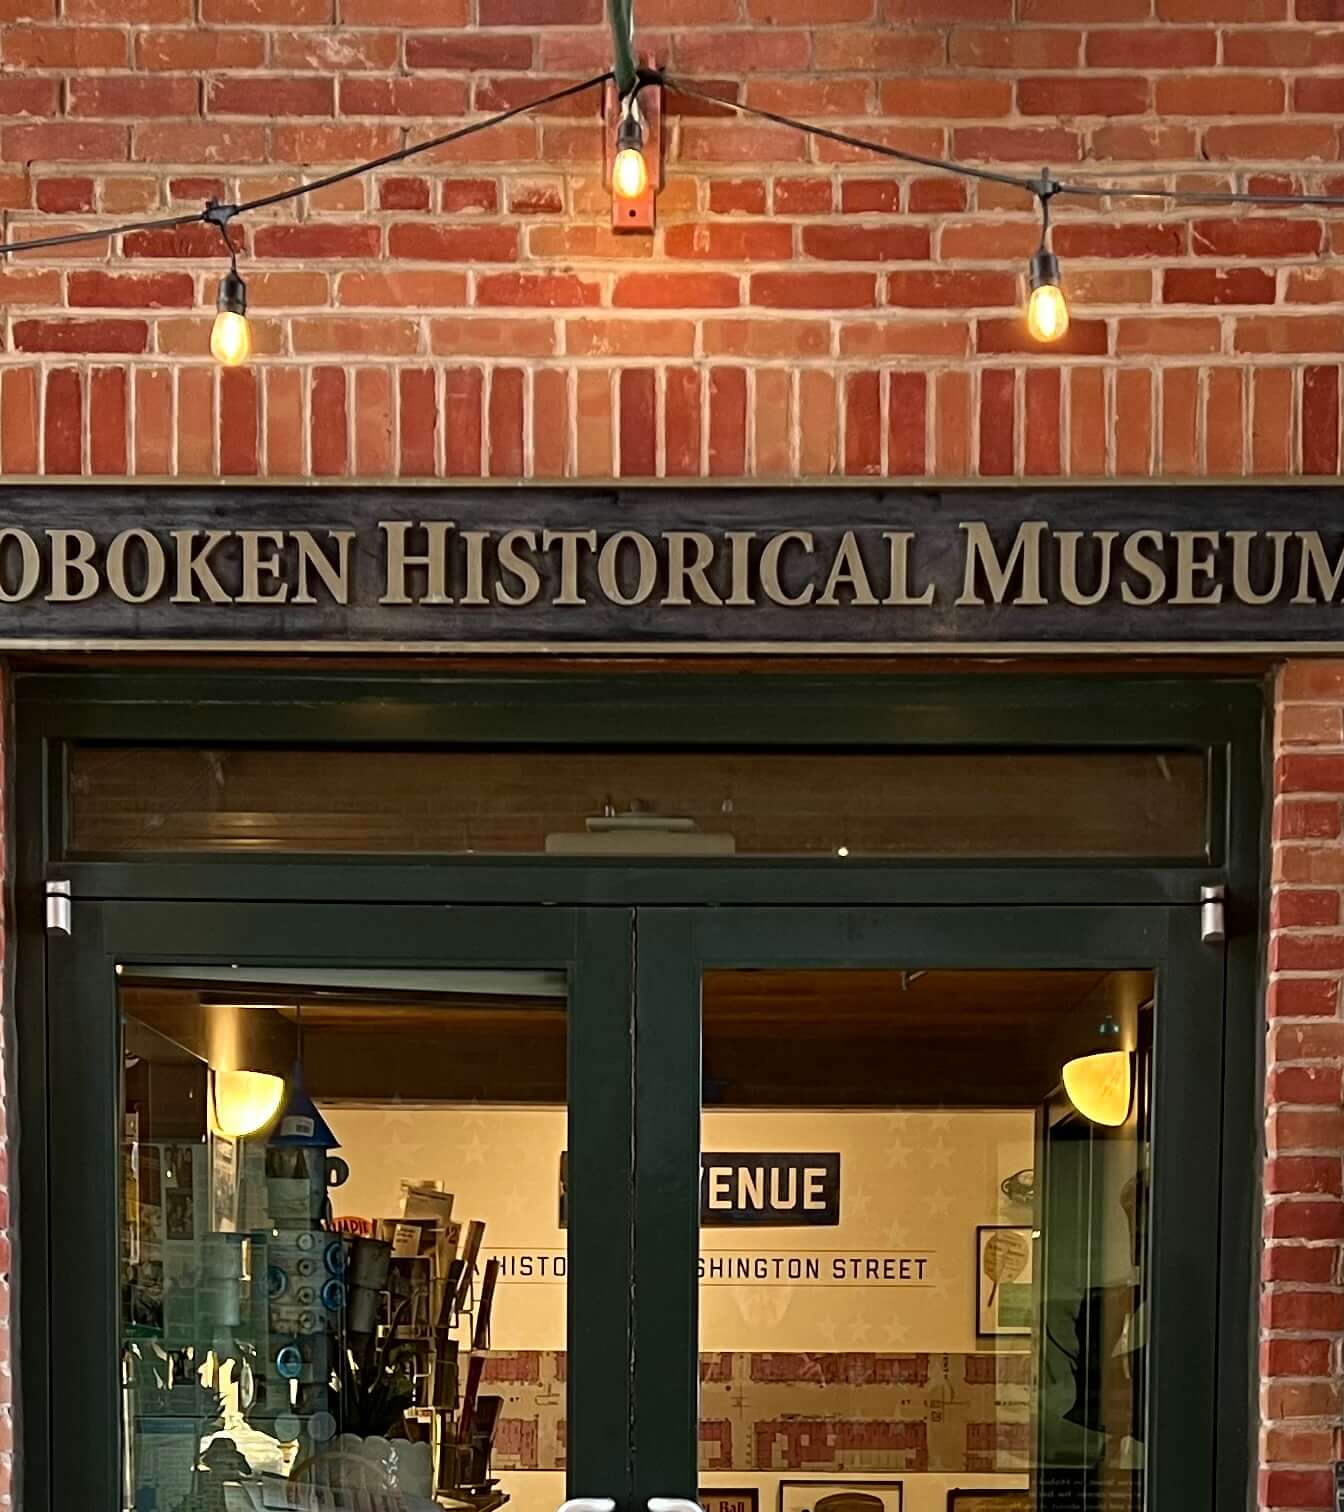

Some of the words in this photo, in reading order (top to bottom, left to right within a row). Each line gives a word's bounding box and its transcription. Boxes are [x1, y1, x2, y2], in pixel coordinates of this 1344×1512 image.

[376, 519, 935, 606] HISTORICAL
[700, 1166, 827, 1210] ENUE
[832, 1258, 928, 1281] STREET
